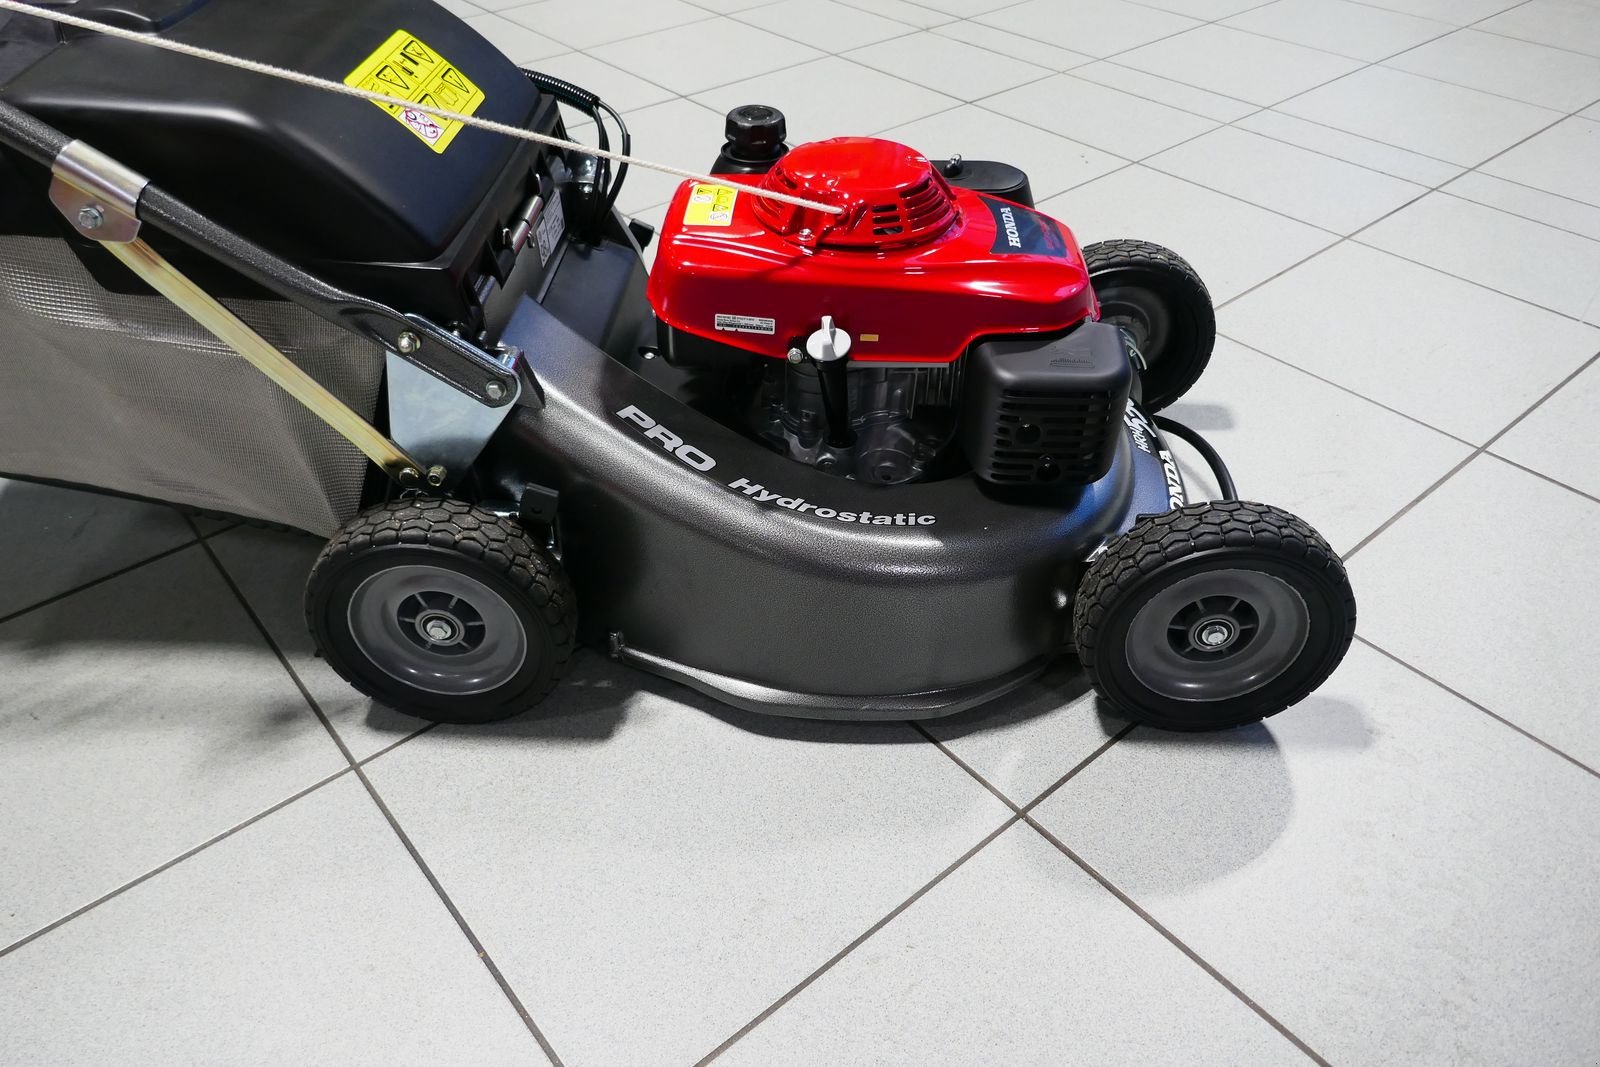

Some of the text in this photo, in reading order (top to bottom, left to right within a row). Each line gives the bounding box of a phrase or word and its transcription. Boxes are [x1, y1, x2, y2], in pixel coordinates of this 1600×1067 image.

[1000, 207, 1021, 248] HONDA
[616, 404, 936, 526] PRO Hydrostatic
[1159, 450, 1184, 510] ONDA
